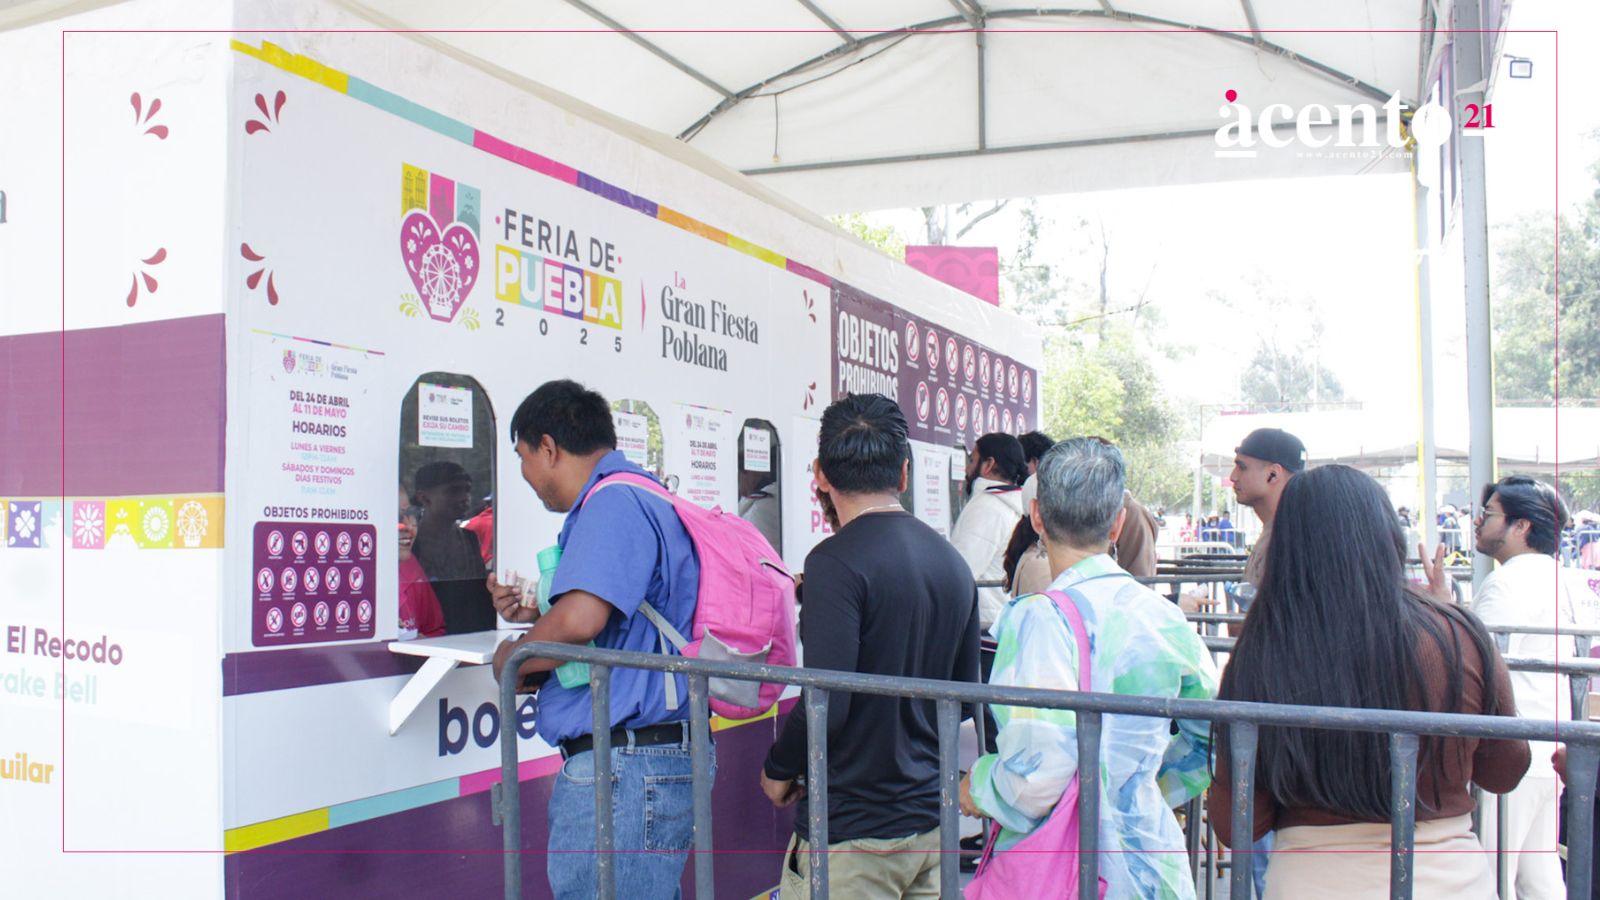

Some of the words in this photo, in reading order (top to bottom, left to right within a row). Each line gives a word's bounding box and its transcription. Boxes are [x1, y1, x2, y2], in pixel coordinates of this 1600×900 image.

[505, 208, 579, 262] FERIA
[590, 236, 615, 273] DE
[498, 247, 622, 325] PUEBLA
[674, 271, 686, 290] La
[661, 285, 706, 330] Gran
[711, 299, 758, 344] Fiesta
[661, 324, 728, 372] Poblana
[839, 311, 899, 373] OBJETOS
[290, 390, 304, 401] DEL
[306, 392, 315, 403] 24
[316, 394, 327, 405] DE
[328, 396, 349, 407] ABRIL
[839, 360, 898, 403] PROHIBIDOS
[292, 420, 346, 437] HORARIOS
[293, 403, 302, 413] AL
[313, 405, 323, 416] DE
[324, 407, 347, 418] MAYO
[291, 442, 312, 451] LUNES
[319, 445, 346, 454] VIERNES
[263, 506, 309, 519] OBJETOS
[311, 508, 369, 520] PROHIBIDOS
[7, 625, 26, 653] El
[34, 628, 123, 665] Recodo
[54, 671, 97, 705] Bell
[438, 696, 537, 757] boe
